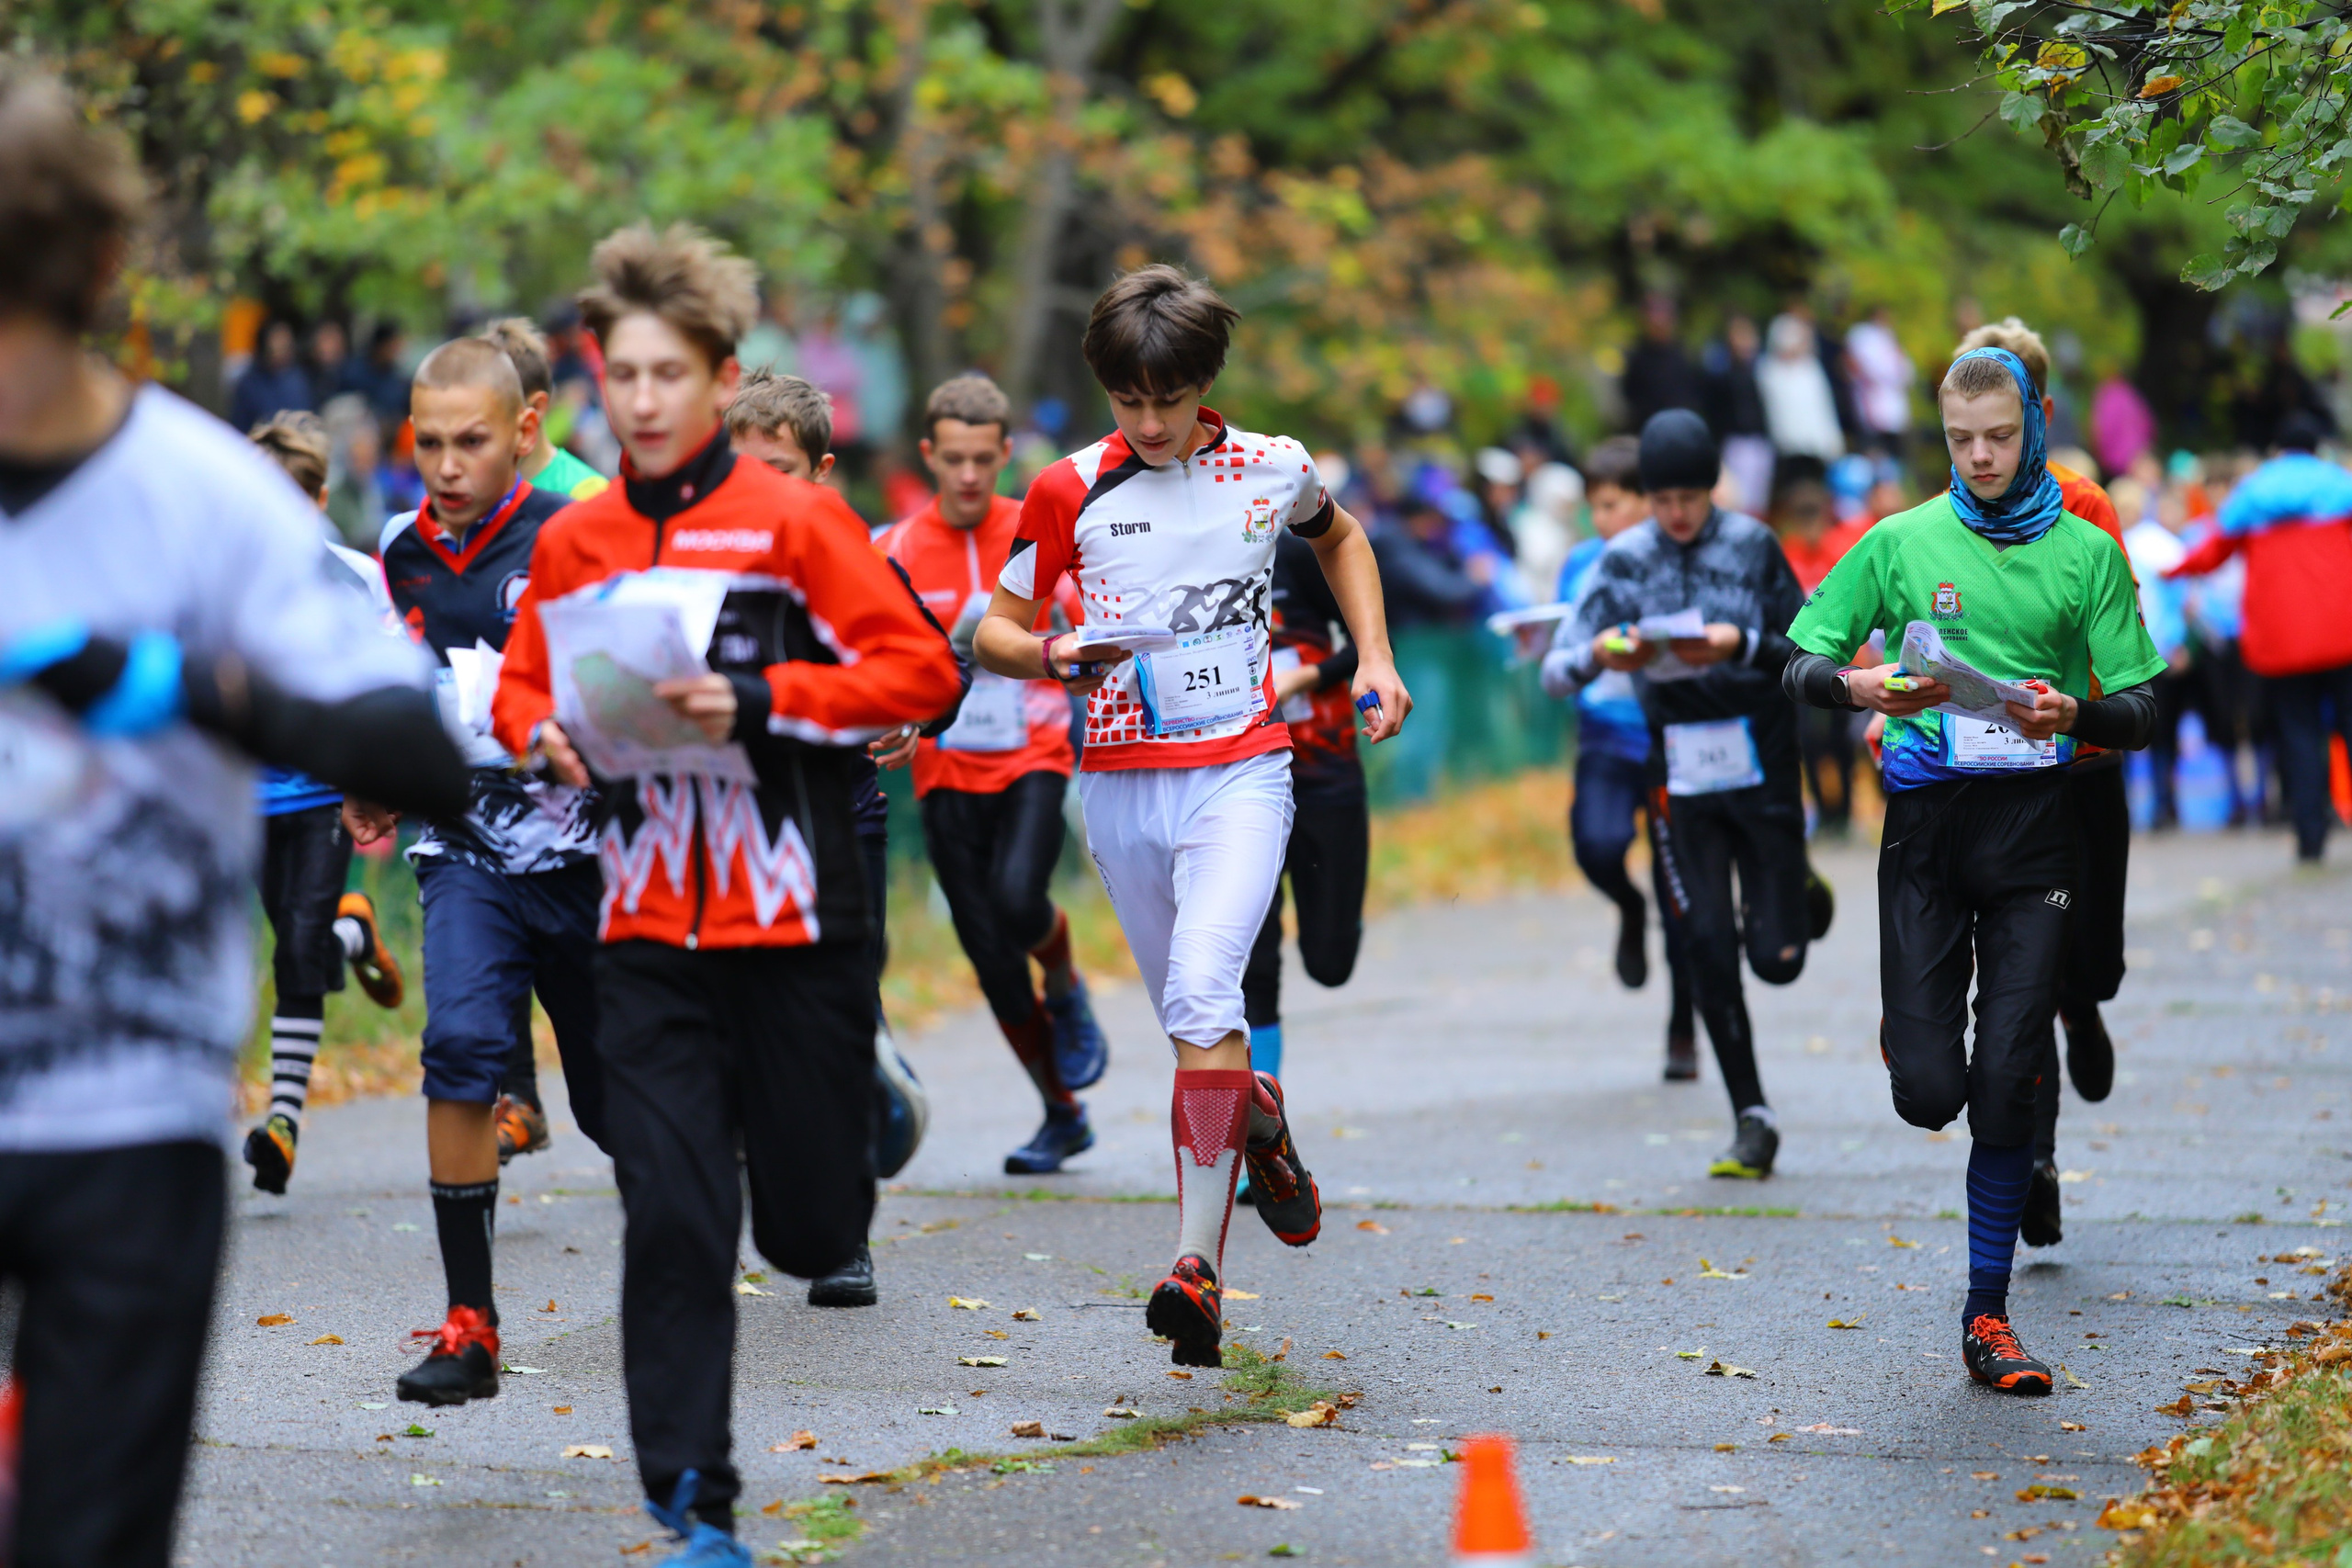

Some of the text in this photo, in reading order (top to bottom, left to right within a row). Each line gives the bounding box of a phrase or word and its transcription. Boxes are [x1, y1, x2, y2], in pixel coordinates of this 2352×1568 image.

[1110, 522, 1151, 537] Storm
[1183, 665, 1223, 692] 251
[1206, 686, 1240, 700] 3 линия
[1161, 716, 1195, 727] ПЕРВЕНСТВО
[2004, 737, 2009, 745] 3
